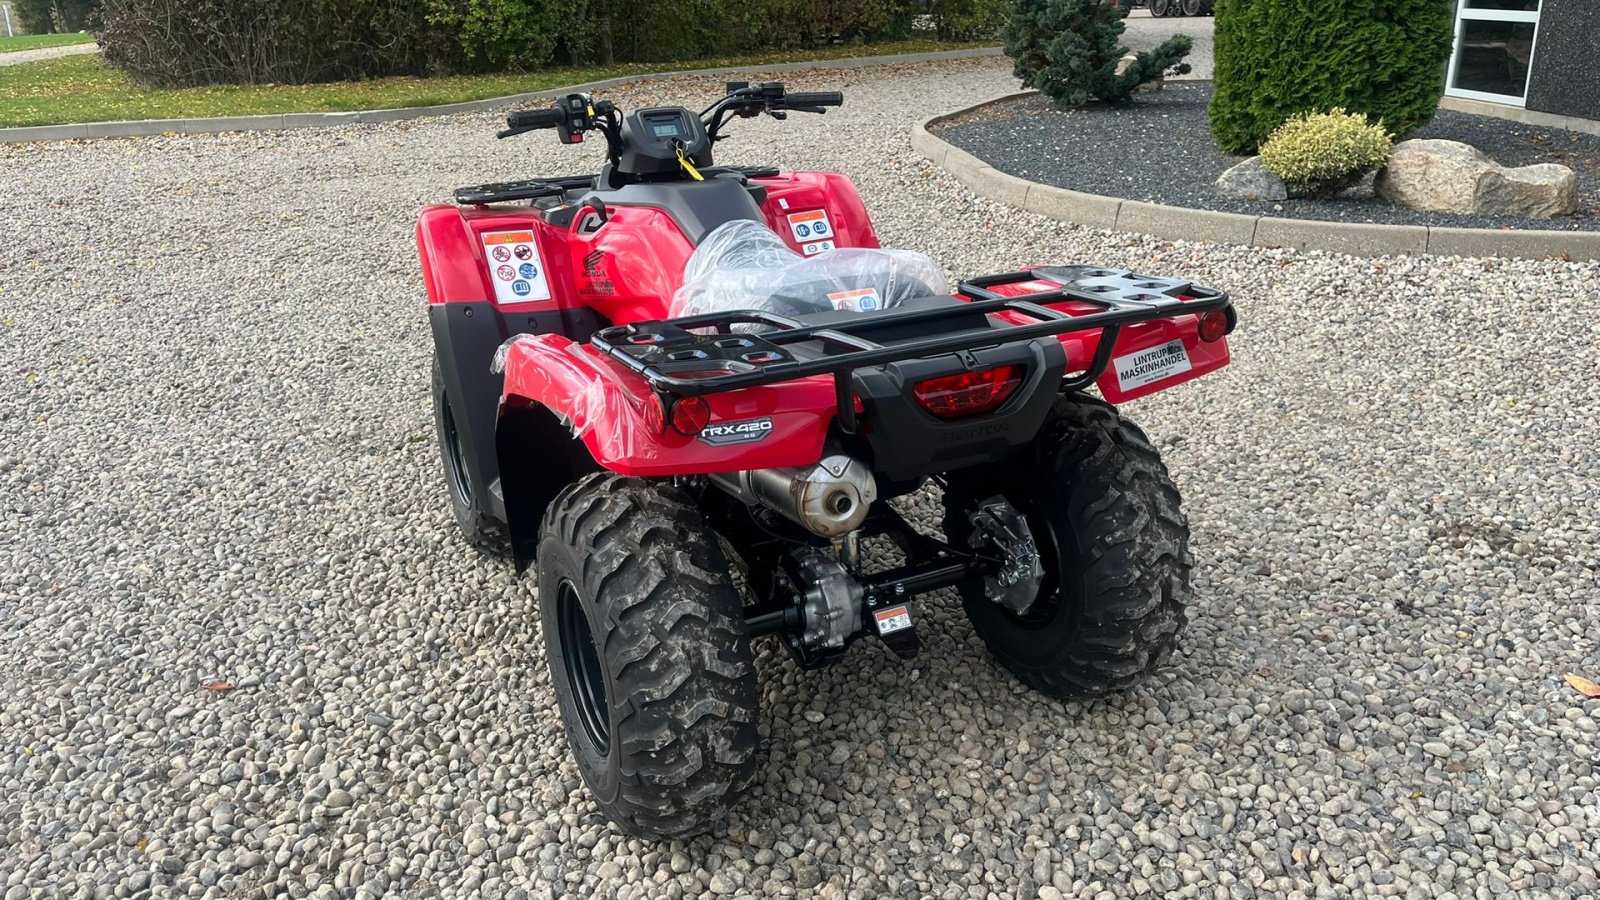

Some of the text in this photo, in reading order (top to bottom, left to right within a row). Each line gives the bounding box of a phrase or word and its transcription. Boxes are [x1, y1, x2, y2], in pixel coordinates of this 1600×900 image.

[581, 270, 607, 278] HONDA
[1133, 347, 1169, 366] LINTRUP
[1120, 352, 1187, 381] MASKINHANDEL
[701, 421, 773, 438] TRX420
